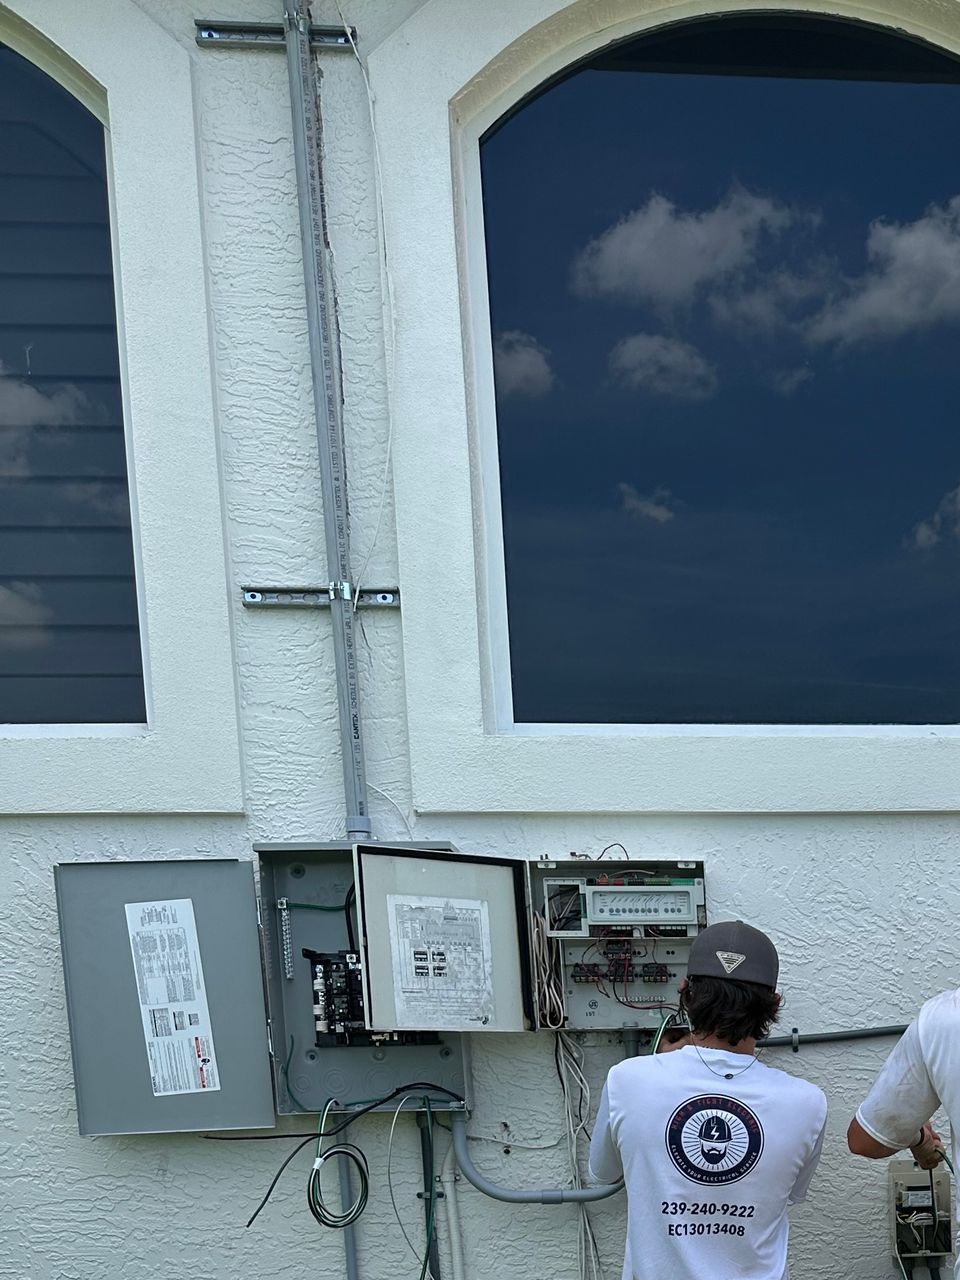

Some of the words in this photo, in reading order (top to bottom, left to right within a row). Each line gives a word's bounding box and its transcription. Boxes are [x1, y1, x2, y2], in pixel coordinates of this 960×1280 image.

[320, 305, 328, 343] ABOVEGROUND
[671, 1144, 688, 1170] ELEVATE
[688, 1168, 701, 1178] YOUR
[702, 1171, 739, 1182] ELECTRICAL
[740, 1152, 758, 1172] SERVICE
[661, 1201, 755, 1218] 239-240-9222
[668, 1222, 746, 1237] EC13013408
